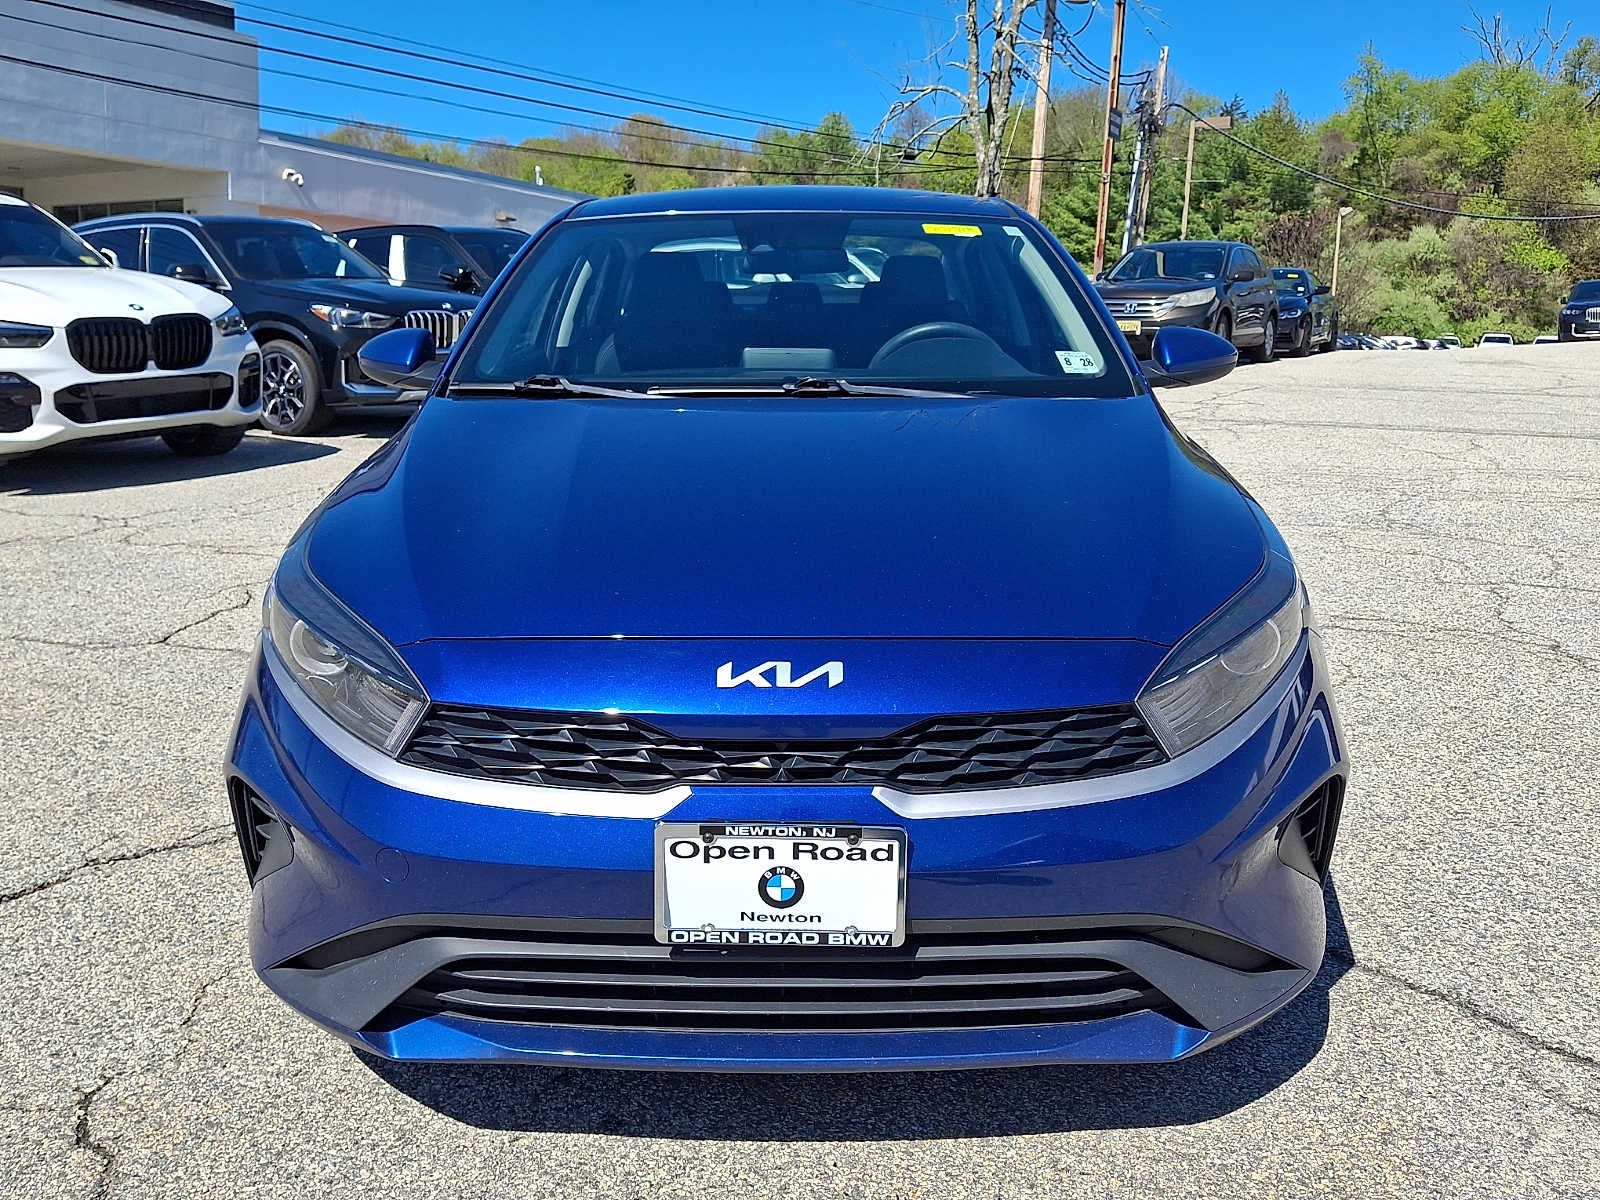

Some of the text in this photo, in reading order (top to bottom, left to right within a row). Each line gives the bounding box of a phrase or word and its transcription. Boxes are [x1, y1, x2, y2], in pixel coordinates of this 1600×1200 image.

[1064, 357, 1094, 367] 8 28
[725, 826, 836, 838] NEWTON, NJ
[669, 840, 894, 864] Open Road
[740, 911, 822, 923] Newton
[671, 931, 890, 946] OPEN ROAD BMW
